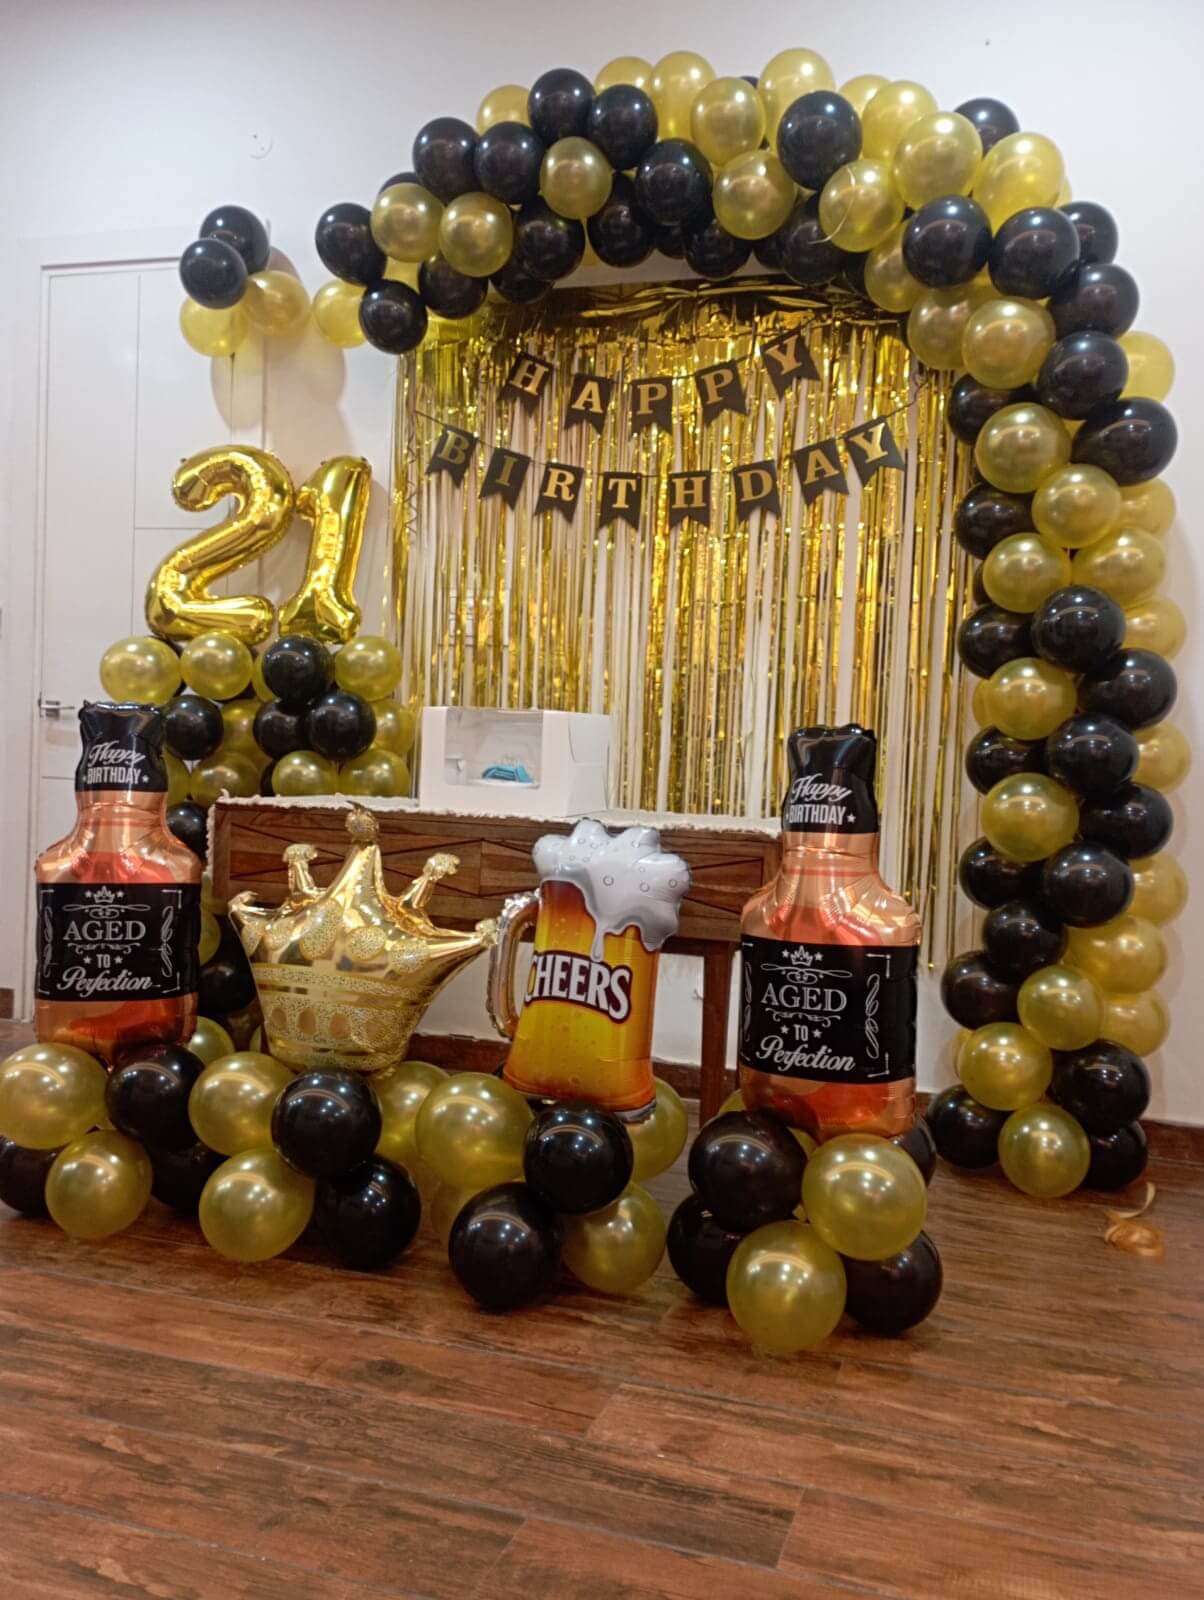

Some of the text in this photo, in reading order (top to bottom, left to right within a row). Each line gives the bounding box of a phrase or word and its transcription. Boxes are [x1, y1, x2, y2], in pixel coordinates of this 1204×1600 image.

[512, 335, 801, 415] HAPPY
[436, 422, 889, 508] BIRTHDAY
[144, 444, 372, 645] 21
[89, 741, 145, 766] Happy
[87, 767, 141, 785] BIRTHDAY
[791, 774, 851, 801] Happy
[788, 804, 847, 826] BIRTHDAY
[62, 919, 147, 942] AGED
[96, 953, 111, 970] TO
[56, 965, 153, 998] Perfection
[760, 983, 848, 1013] AGED
[794, 1023, 810, 1043] TO
[755, 1034, 856, 1073] Perfection
